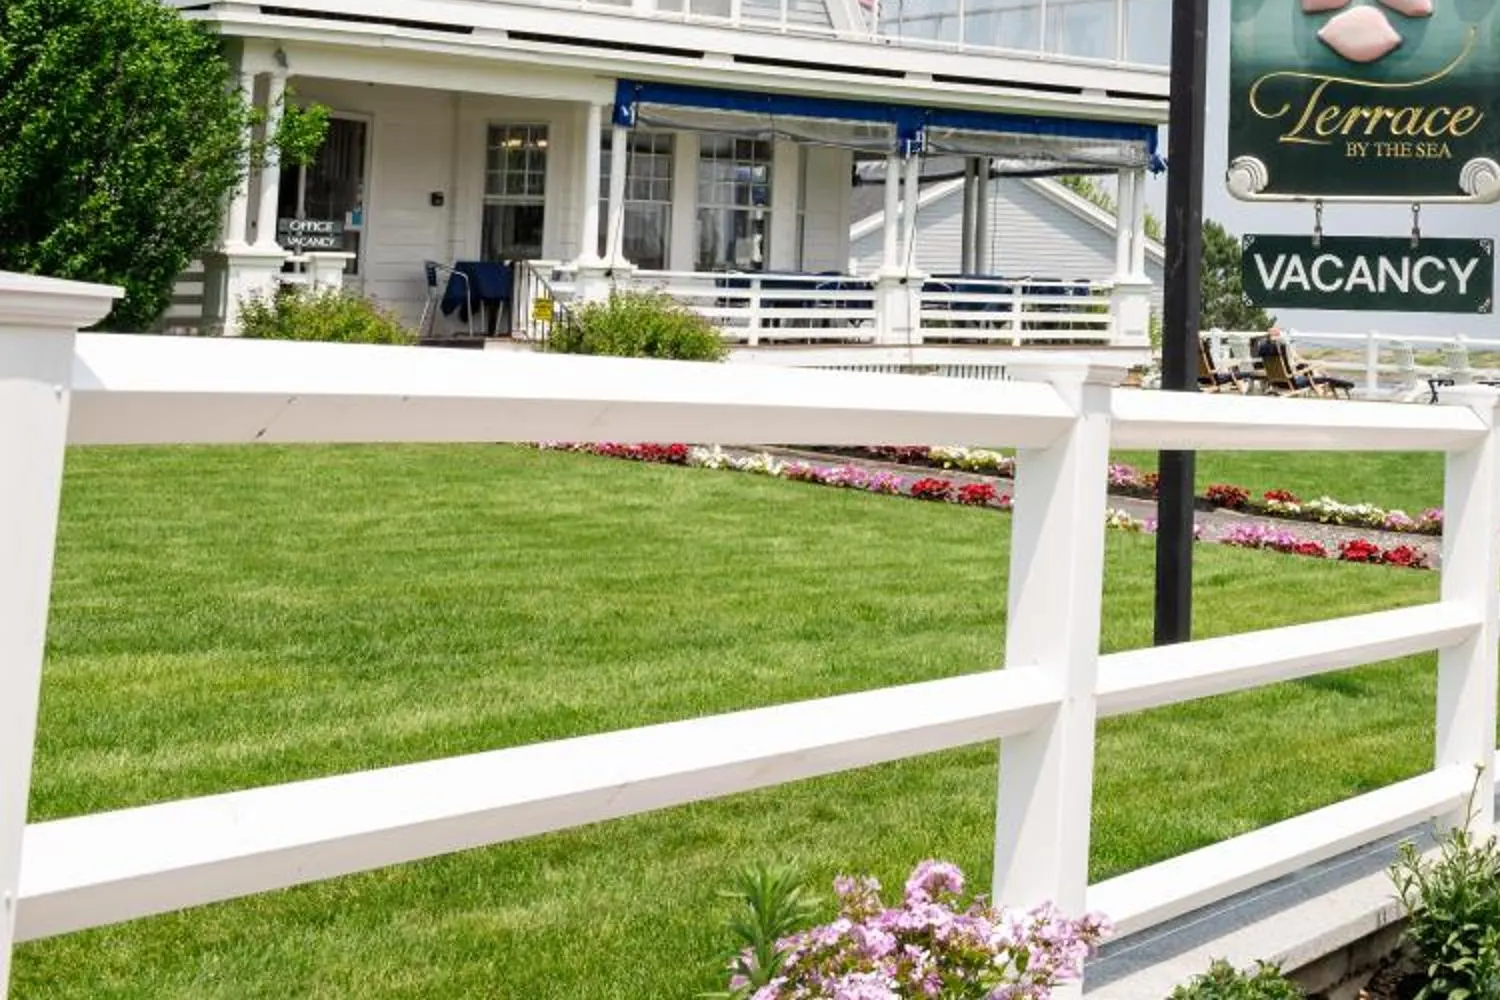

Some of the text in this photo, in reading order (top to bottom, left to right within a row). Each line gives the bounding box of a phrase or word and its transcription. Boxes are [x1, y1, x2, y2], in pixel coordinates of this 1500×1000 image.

[1249, 24, 1484, 145] Terrace
[1345, 141, 1452, 159] BY THE SEA
[289, 220, 335, 232] OFFICE
[287, 236, 335, 247] VACANCY
[1253, 253, 1480, 295] VACANCY
